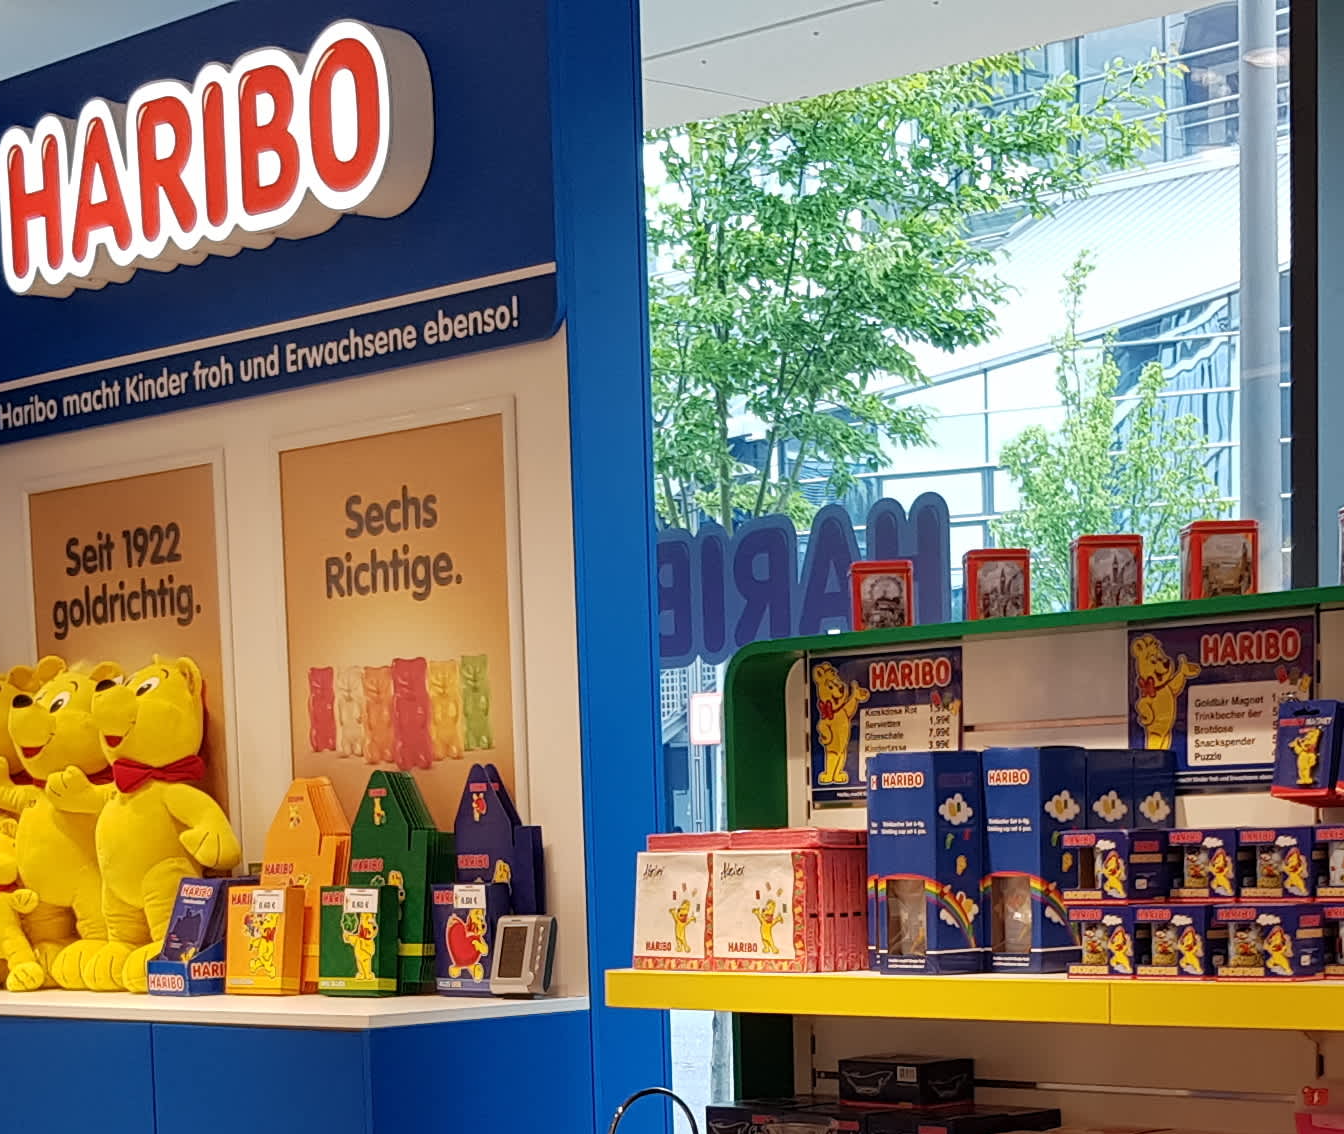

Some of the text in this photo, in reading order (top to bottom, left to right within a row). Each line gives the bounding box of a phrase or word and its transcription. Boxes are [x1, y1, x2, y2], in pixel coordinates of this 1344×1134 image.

[1, 26, 386, 290] HARIBO
[63, 384, 121, 416] macht
[125, 371, 188, 407] Kinder
[193, 359, 233, 392] froh
[240, 346, 280, 382] und
[286, 324, 417, 374] Erwachsene
[424, 296, 519, 343] ebenso!
[345, 487, 438, 538] Sechs
[65, 523, 181, 577] Seit 1922
[325, 548, 463, 601] Richtige.
[53, 575, 202, 640] goldrichtig.
[1201, 628, 1301, 666] HARIBO
[869, 657, 952, 691] HARIBO
[1194, 752, 1222, 761] Puzzle
[882, 772, 924, 788] HARIBO
[988, 769, 1029, 785] HARIBO
[264, 863, 294, 875] HARIBO
[181, 883, 214, 899] HARIBO
[728, 942, 758, 953] HARIBO
[149, 974, 185, 991] HARIBO
